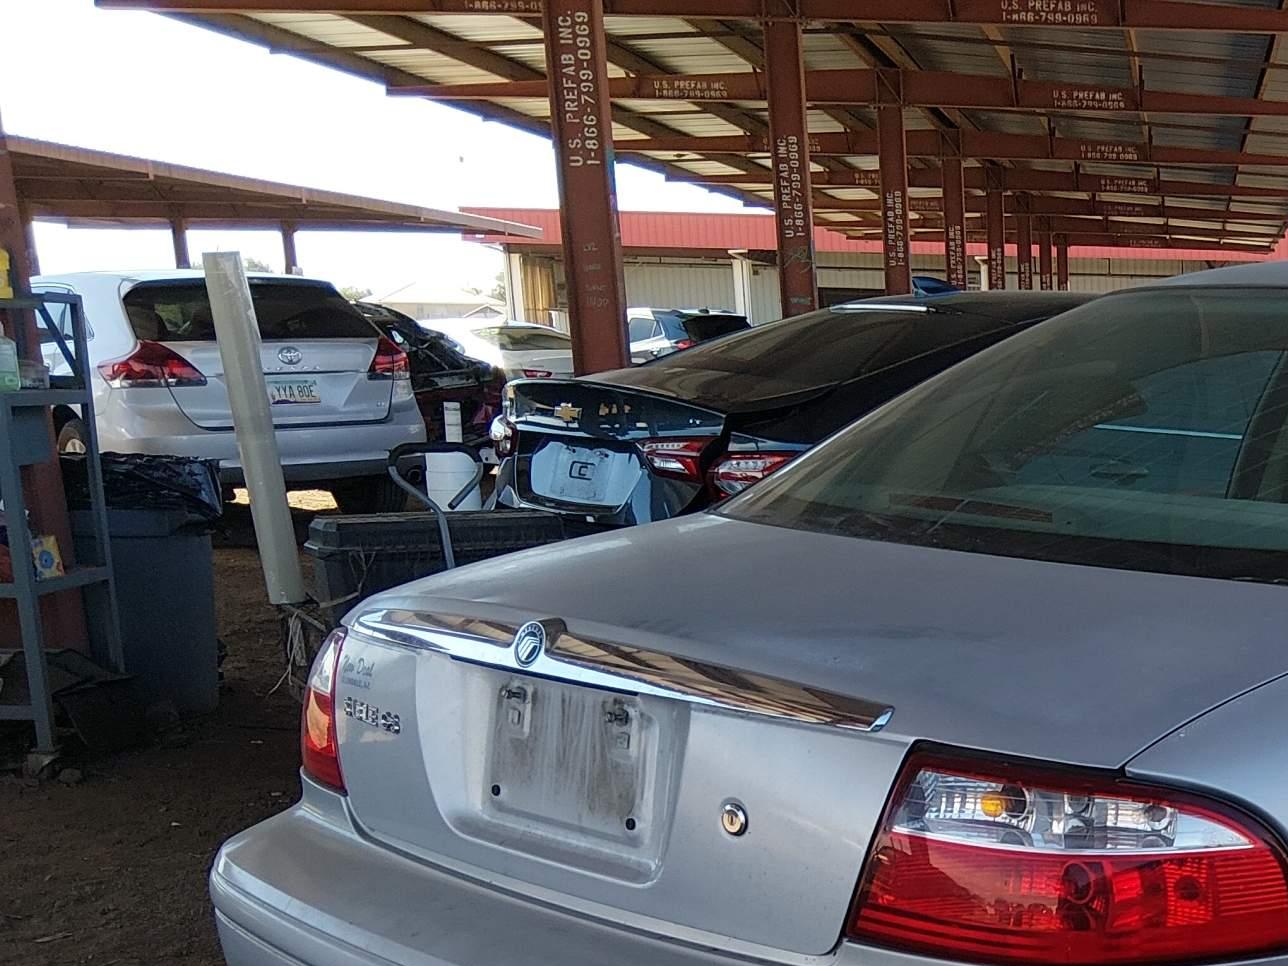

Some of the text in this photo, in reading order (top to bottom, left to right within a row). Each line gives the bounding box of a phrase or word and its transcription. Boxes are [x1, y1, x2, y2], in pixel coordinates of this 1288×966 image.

[1028, 0, 1072, 12] PREFAB
[1076, 2, 1098, 13] INC.
[558, 10, 584, 167] U.S. PREFAB INC.
[575, 11, 601, 165] 1-866-799-0969
[674, 80, 707, 90] PREFAB
[776, 135, 795, 238] U.S. PREFAB INC.
[787, 135, 805, 237] 1-866-799-0969
[886, 210, 896, 246] PREFAB
